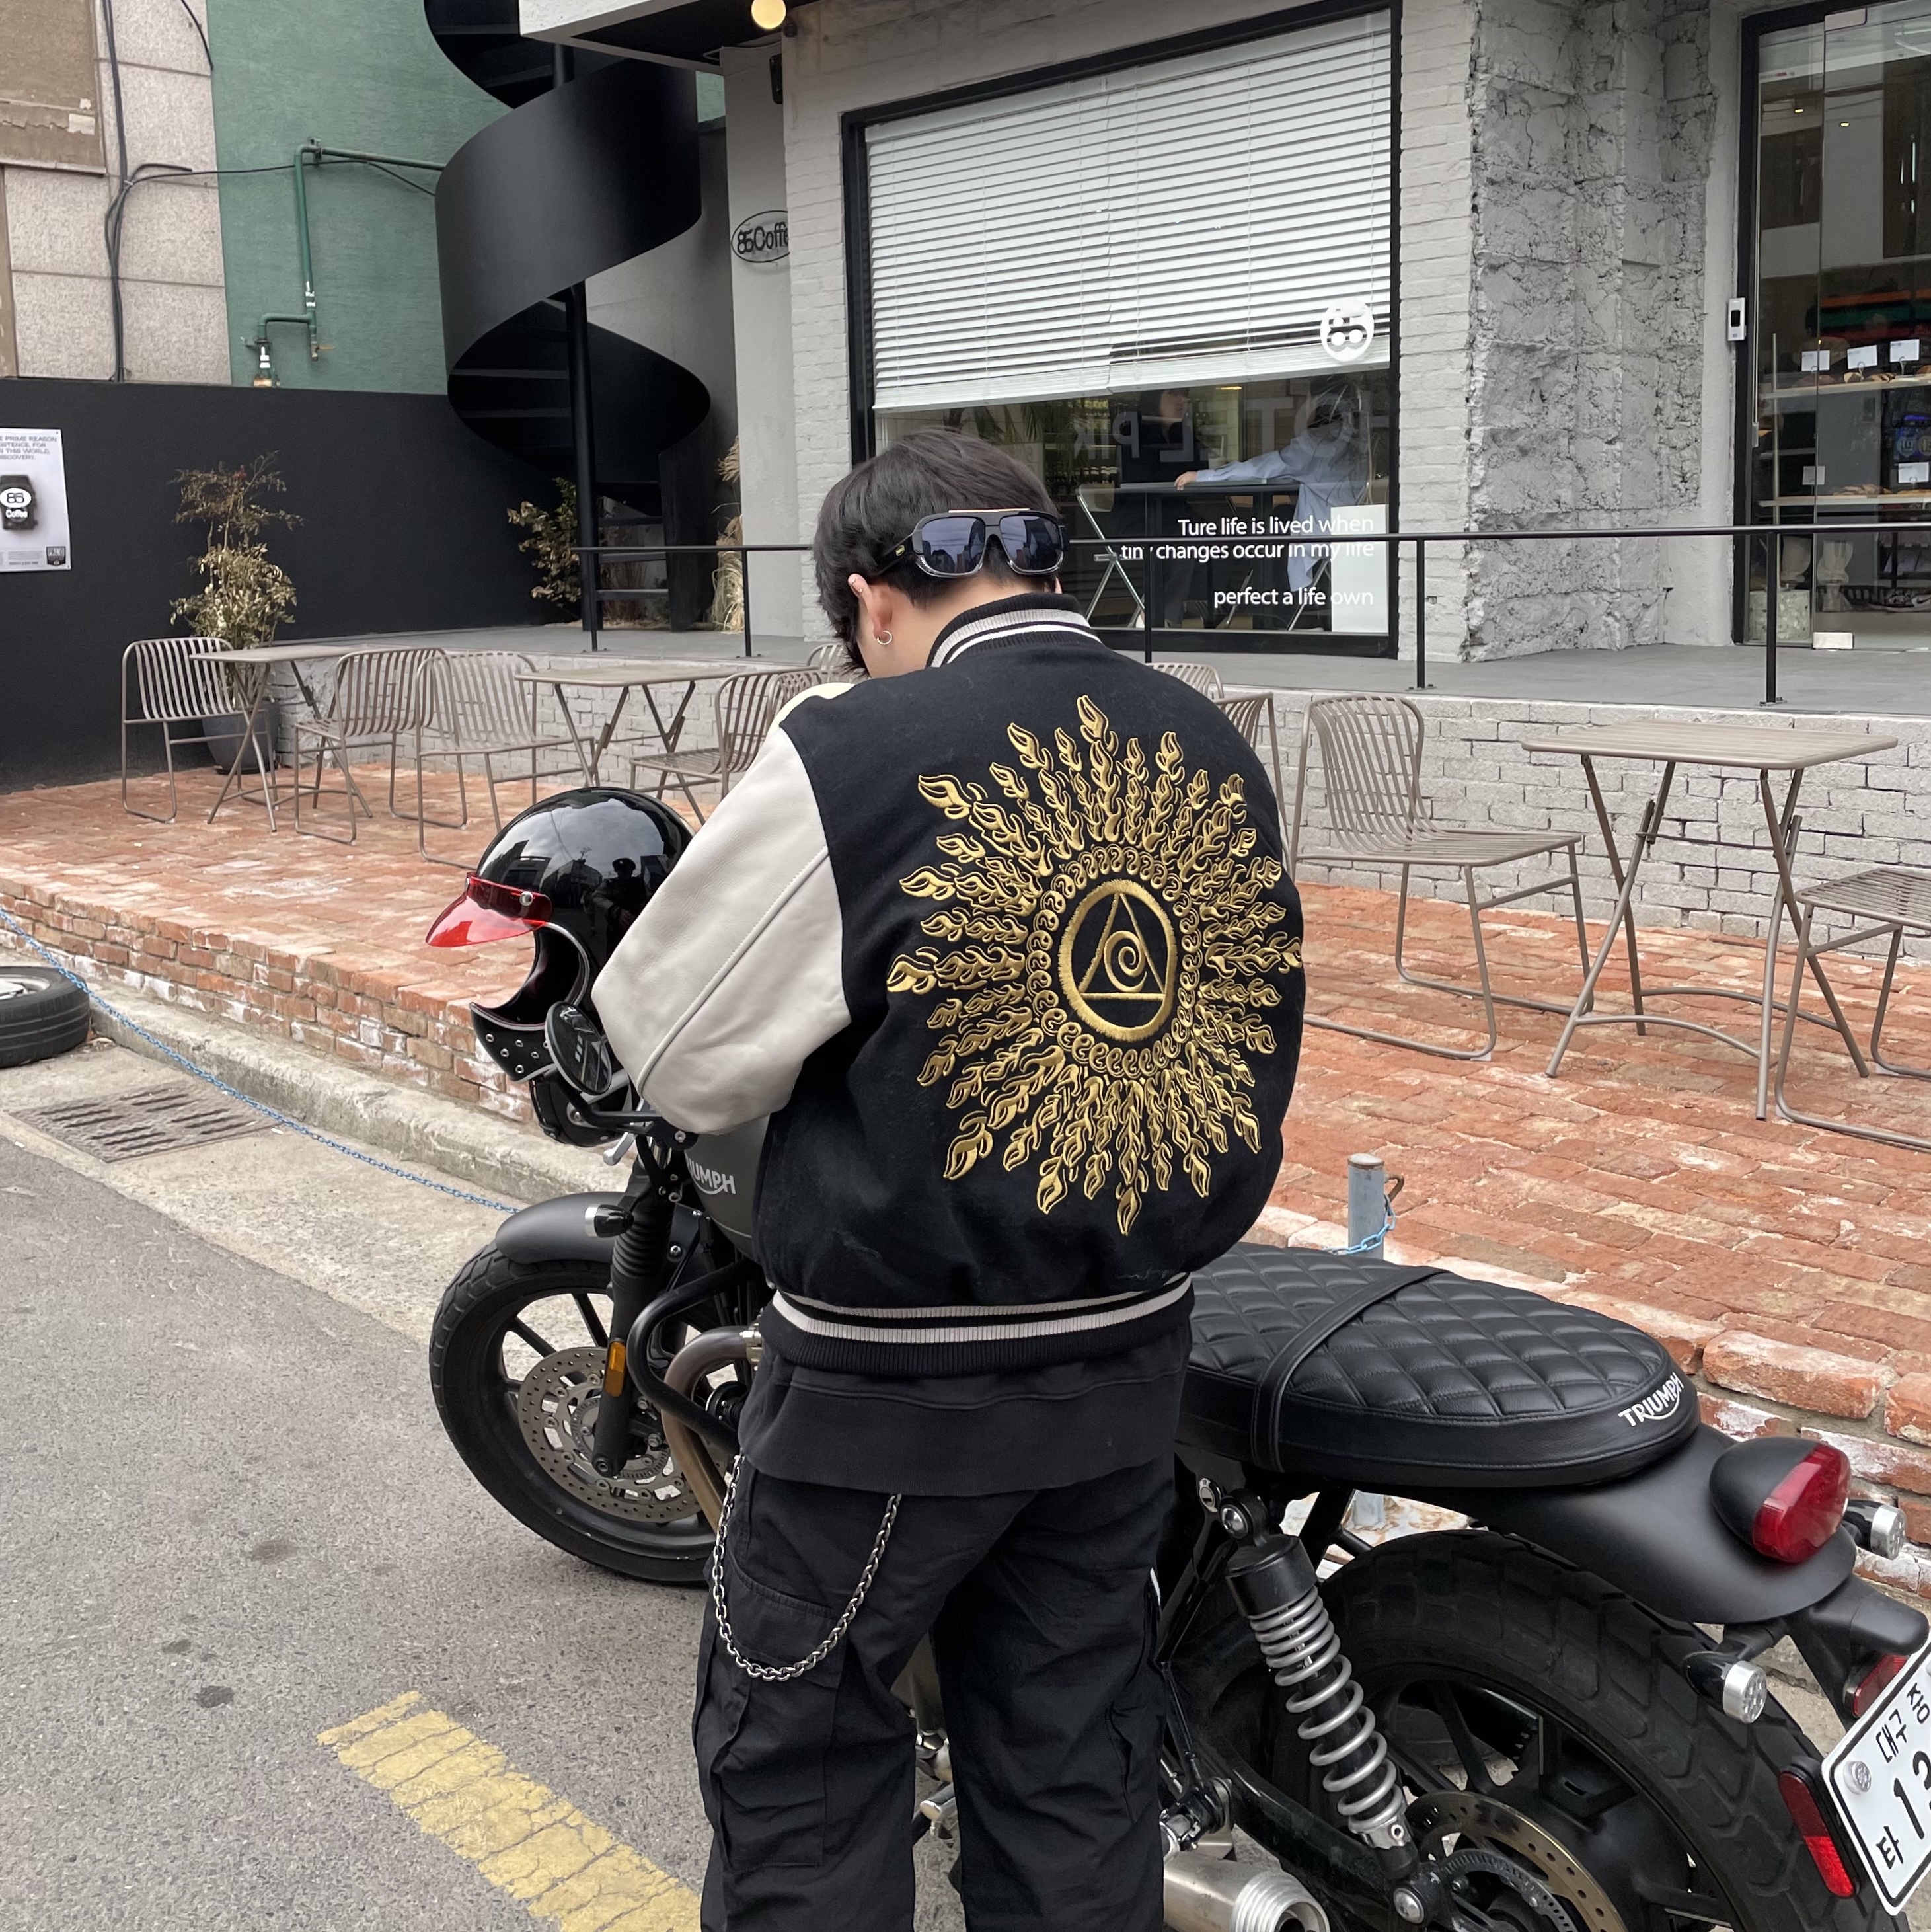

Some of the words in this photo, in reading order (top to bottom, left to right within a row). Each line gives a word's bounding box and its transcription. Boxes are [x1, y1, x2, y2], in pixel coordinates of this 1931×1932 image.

[1178, 519, 1217, 536] Ture
[1221, 517, 1247, 535] life
[1252, 517, 1265, 535] is
[1270, 515, 1314, 534] lived
[1318, 514, 1374, 533] when
[1156, 544, 1229, 562] changes
[1233, 544, 1285, 559] occur
[1289, 543, 1305, 557] in
[1311, 543, 1342, 562] my
[1346, 541, 1375, 557] life
[1214, 587, 1278, 608] perfect
[1283, 591, 1293, 605] a
[1299, 587, 1326, 605] life
[1331, 591, 1373, 605] own
[1618, 1372, 1684, 1426] TRIUMPH
[1876, 1709, 1907, 1763] 대구
[1876, 1826, 1903, 1869] 타
